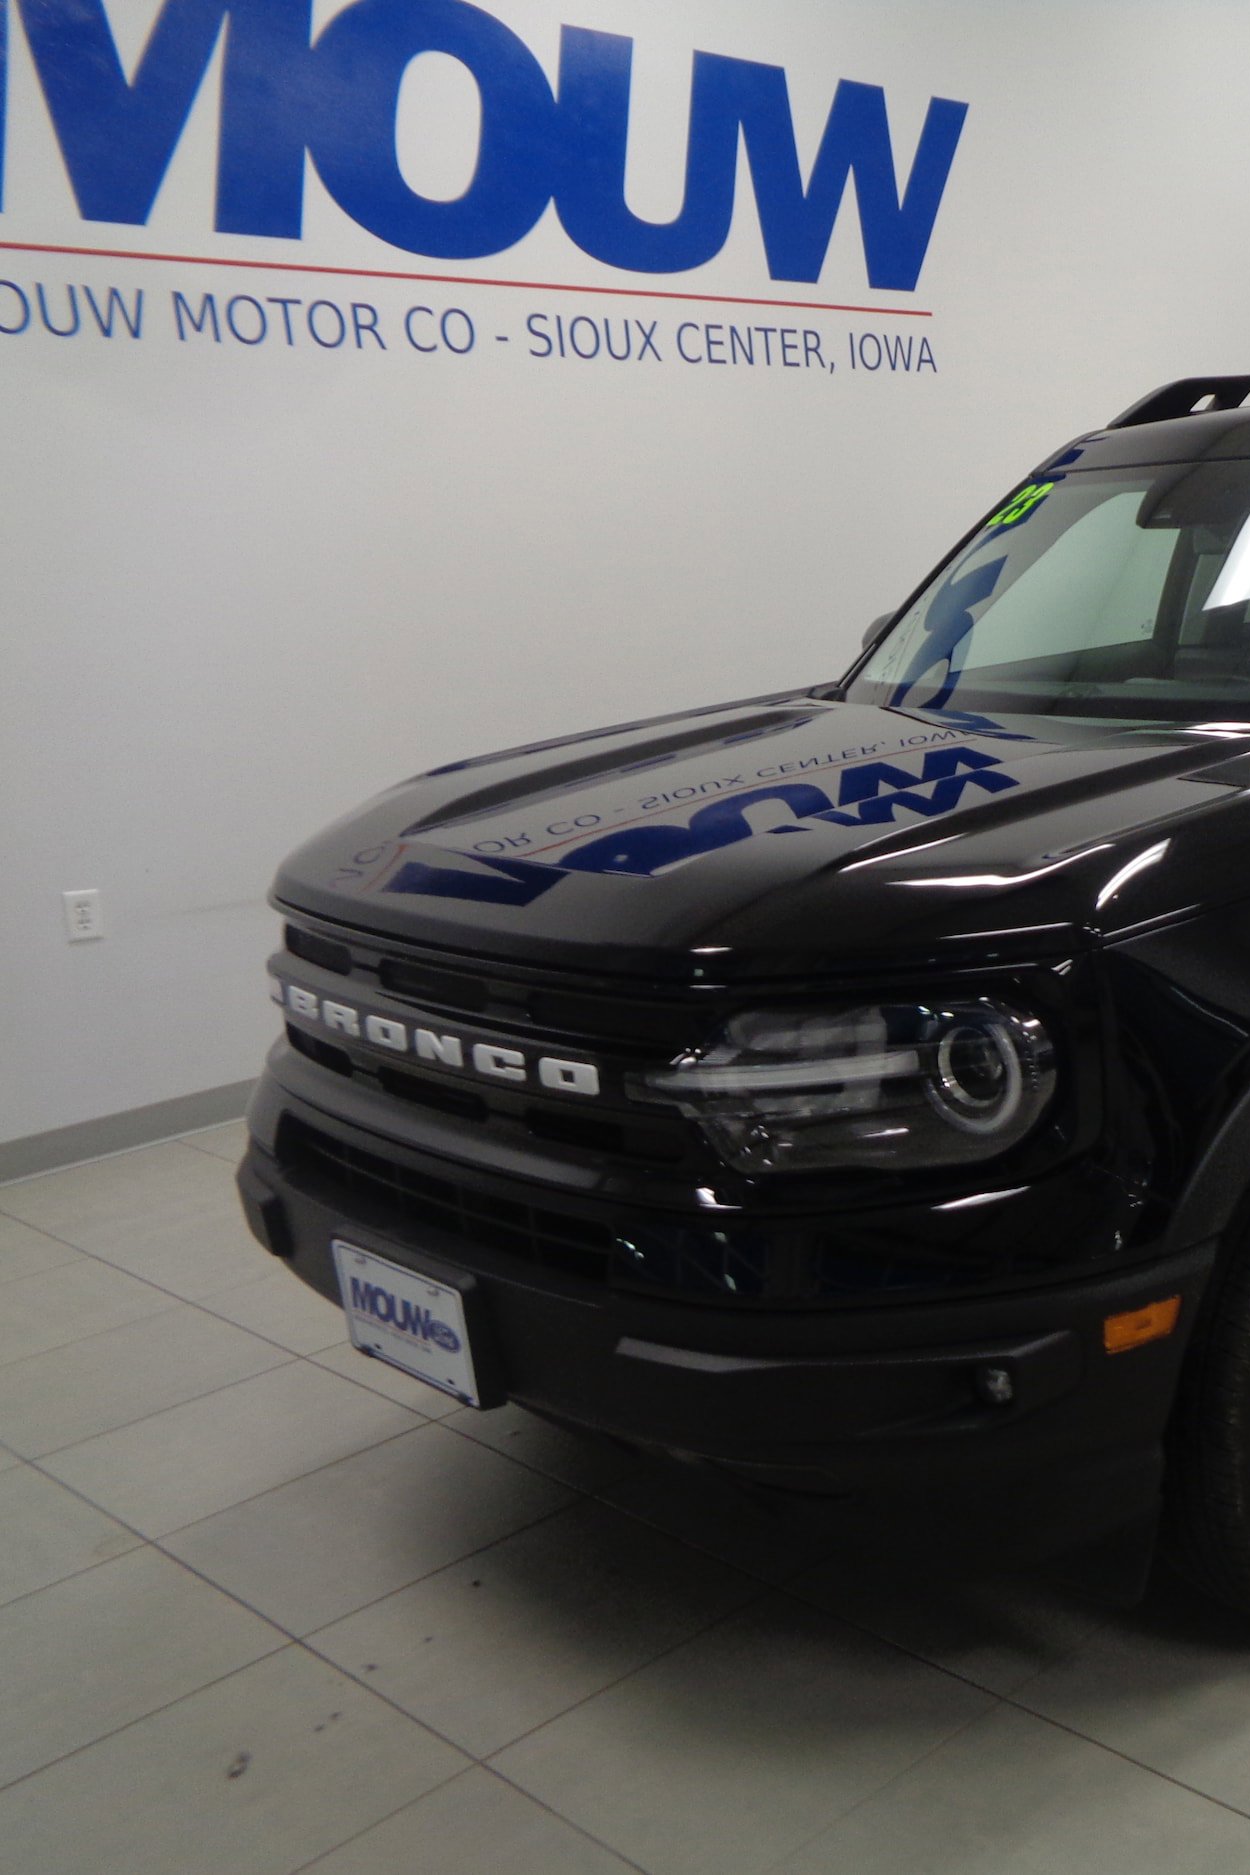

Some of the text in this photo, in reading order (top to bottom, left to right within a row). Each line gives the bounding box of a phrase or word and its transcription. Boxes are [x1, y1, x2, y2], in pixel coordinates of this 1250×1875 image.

[0, 0, 969, 292] MOUW
[171, 290, 388, 351] MOTOR
[404, 305, 476, 354] CO
[525, 313, 663, 362] SIOUX
[675, 323, 836, 374] CENTER,
[848, 332, 938, 373] IOWA
[288, 985, 600, 1097] BRONCO
[350, 1276, 432, 1340] MOUW
